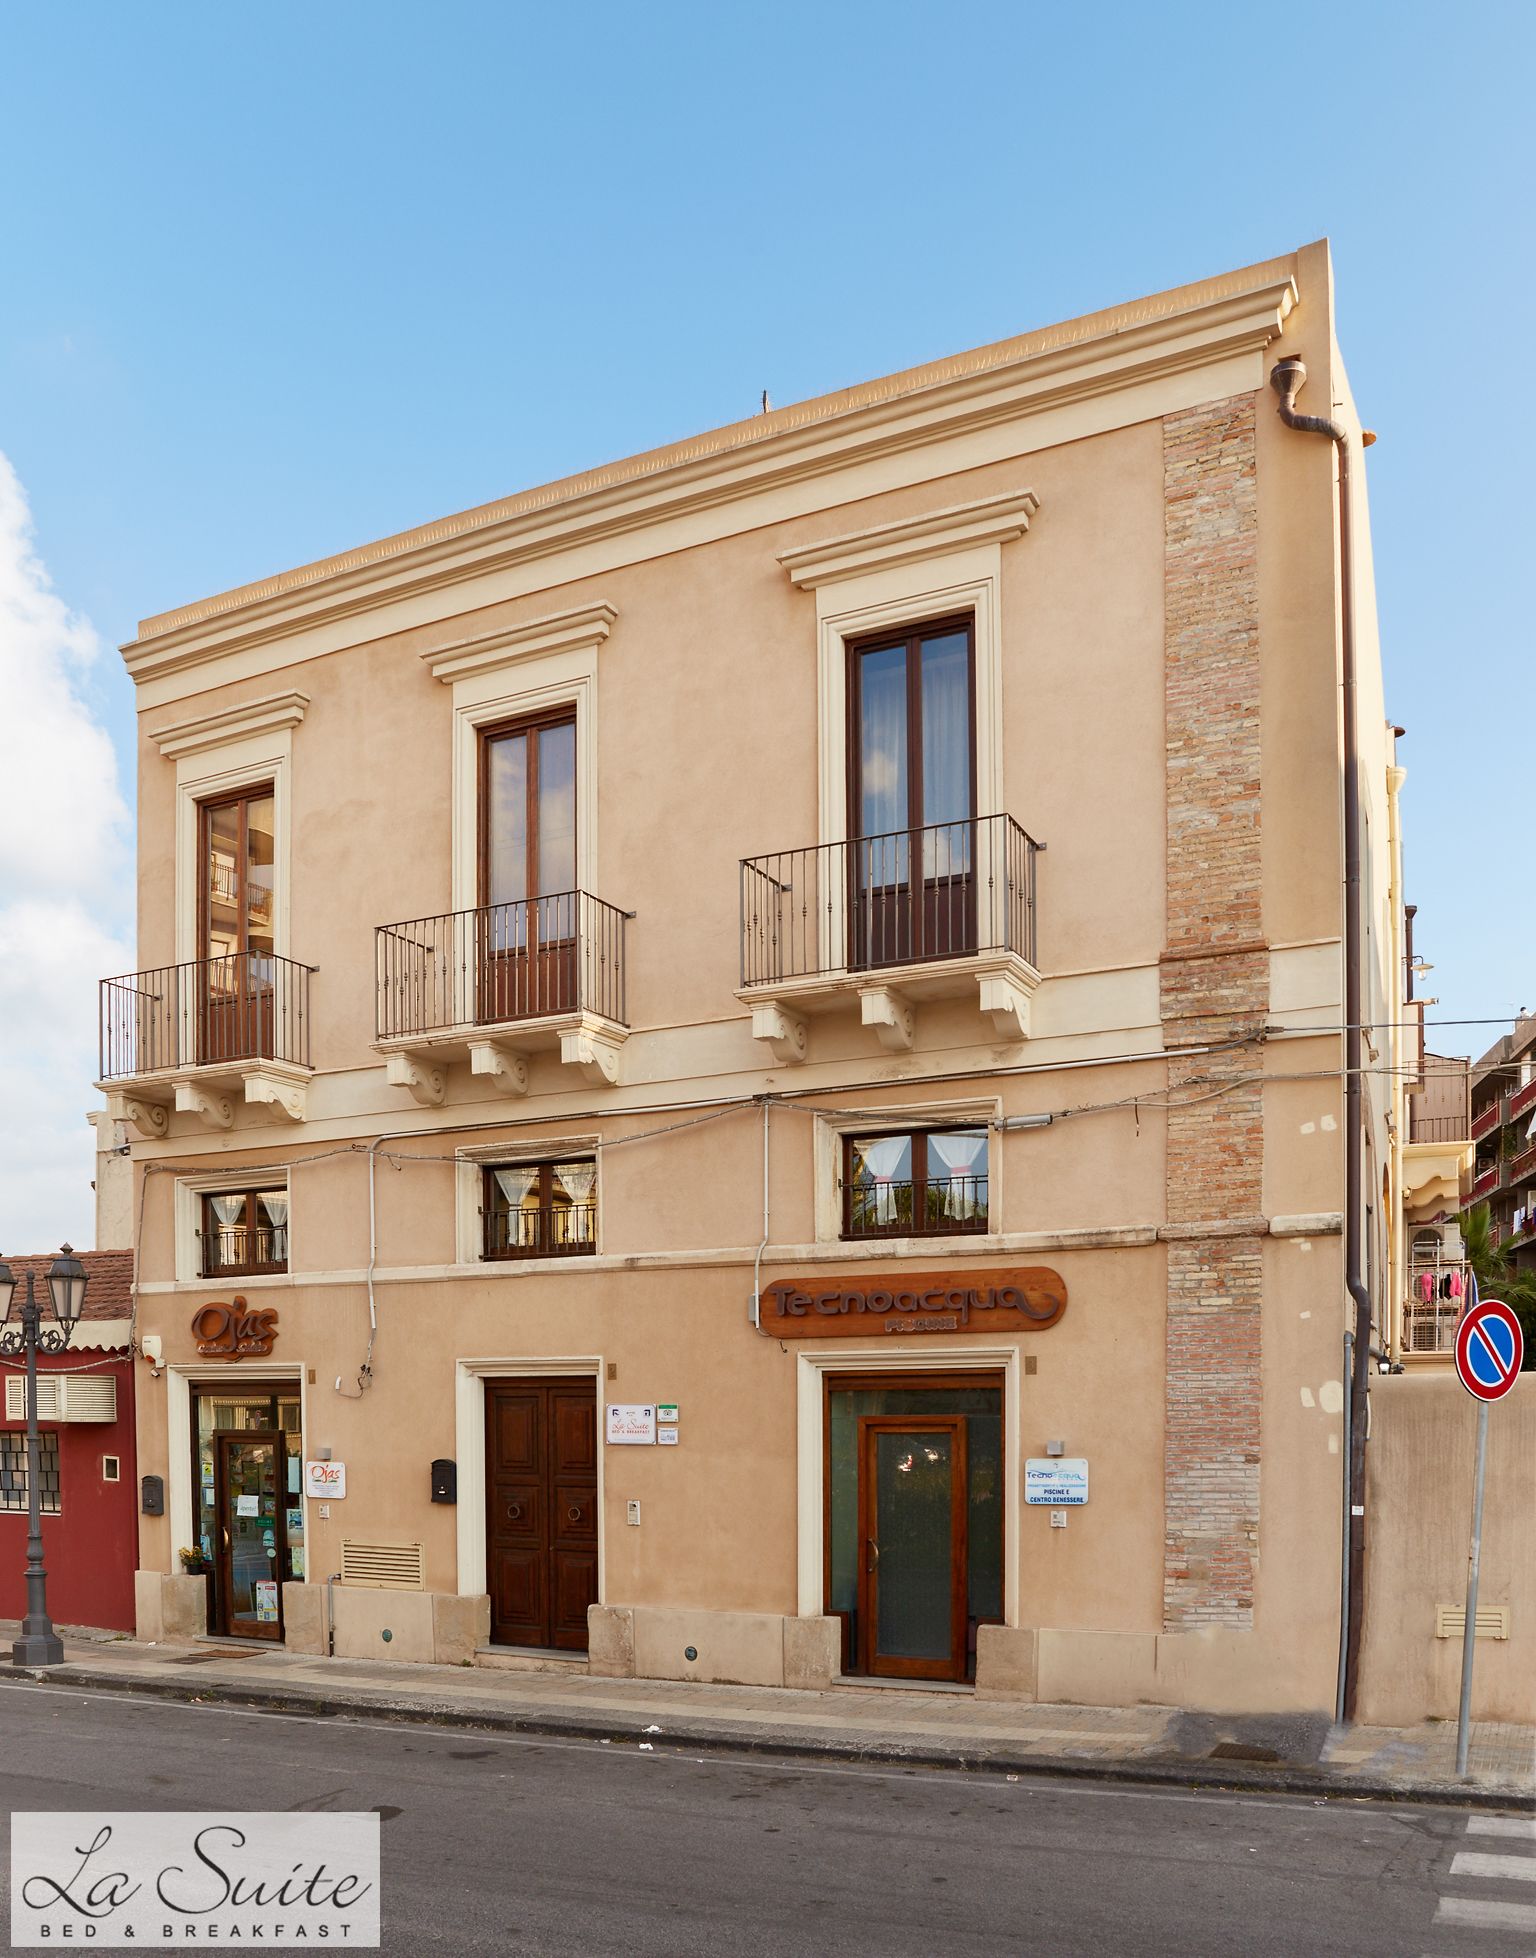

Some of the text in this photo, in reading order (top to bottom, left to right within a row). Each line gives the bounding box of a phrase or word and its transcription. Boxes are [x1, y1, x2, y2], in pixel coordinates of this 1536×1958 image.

[769, 1286, 1058, 1324] Tecnoacqua
[191, 1301, 273, 1353] Ojas
[884, 1316, 957, 1332] PISCINE
[311, 1464, 340, 1483] Ojas
